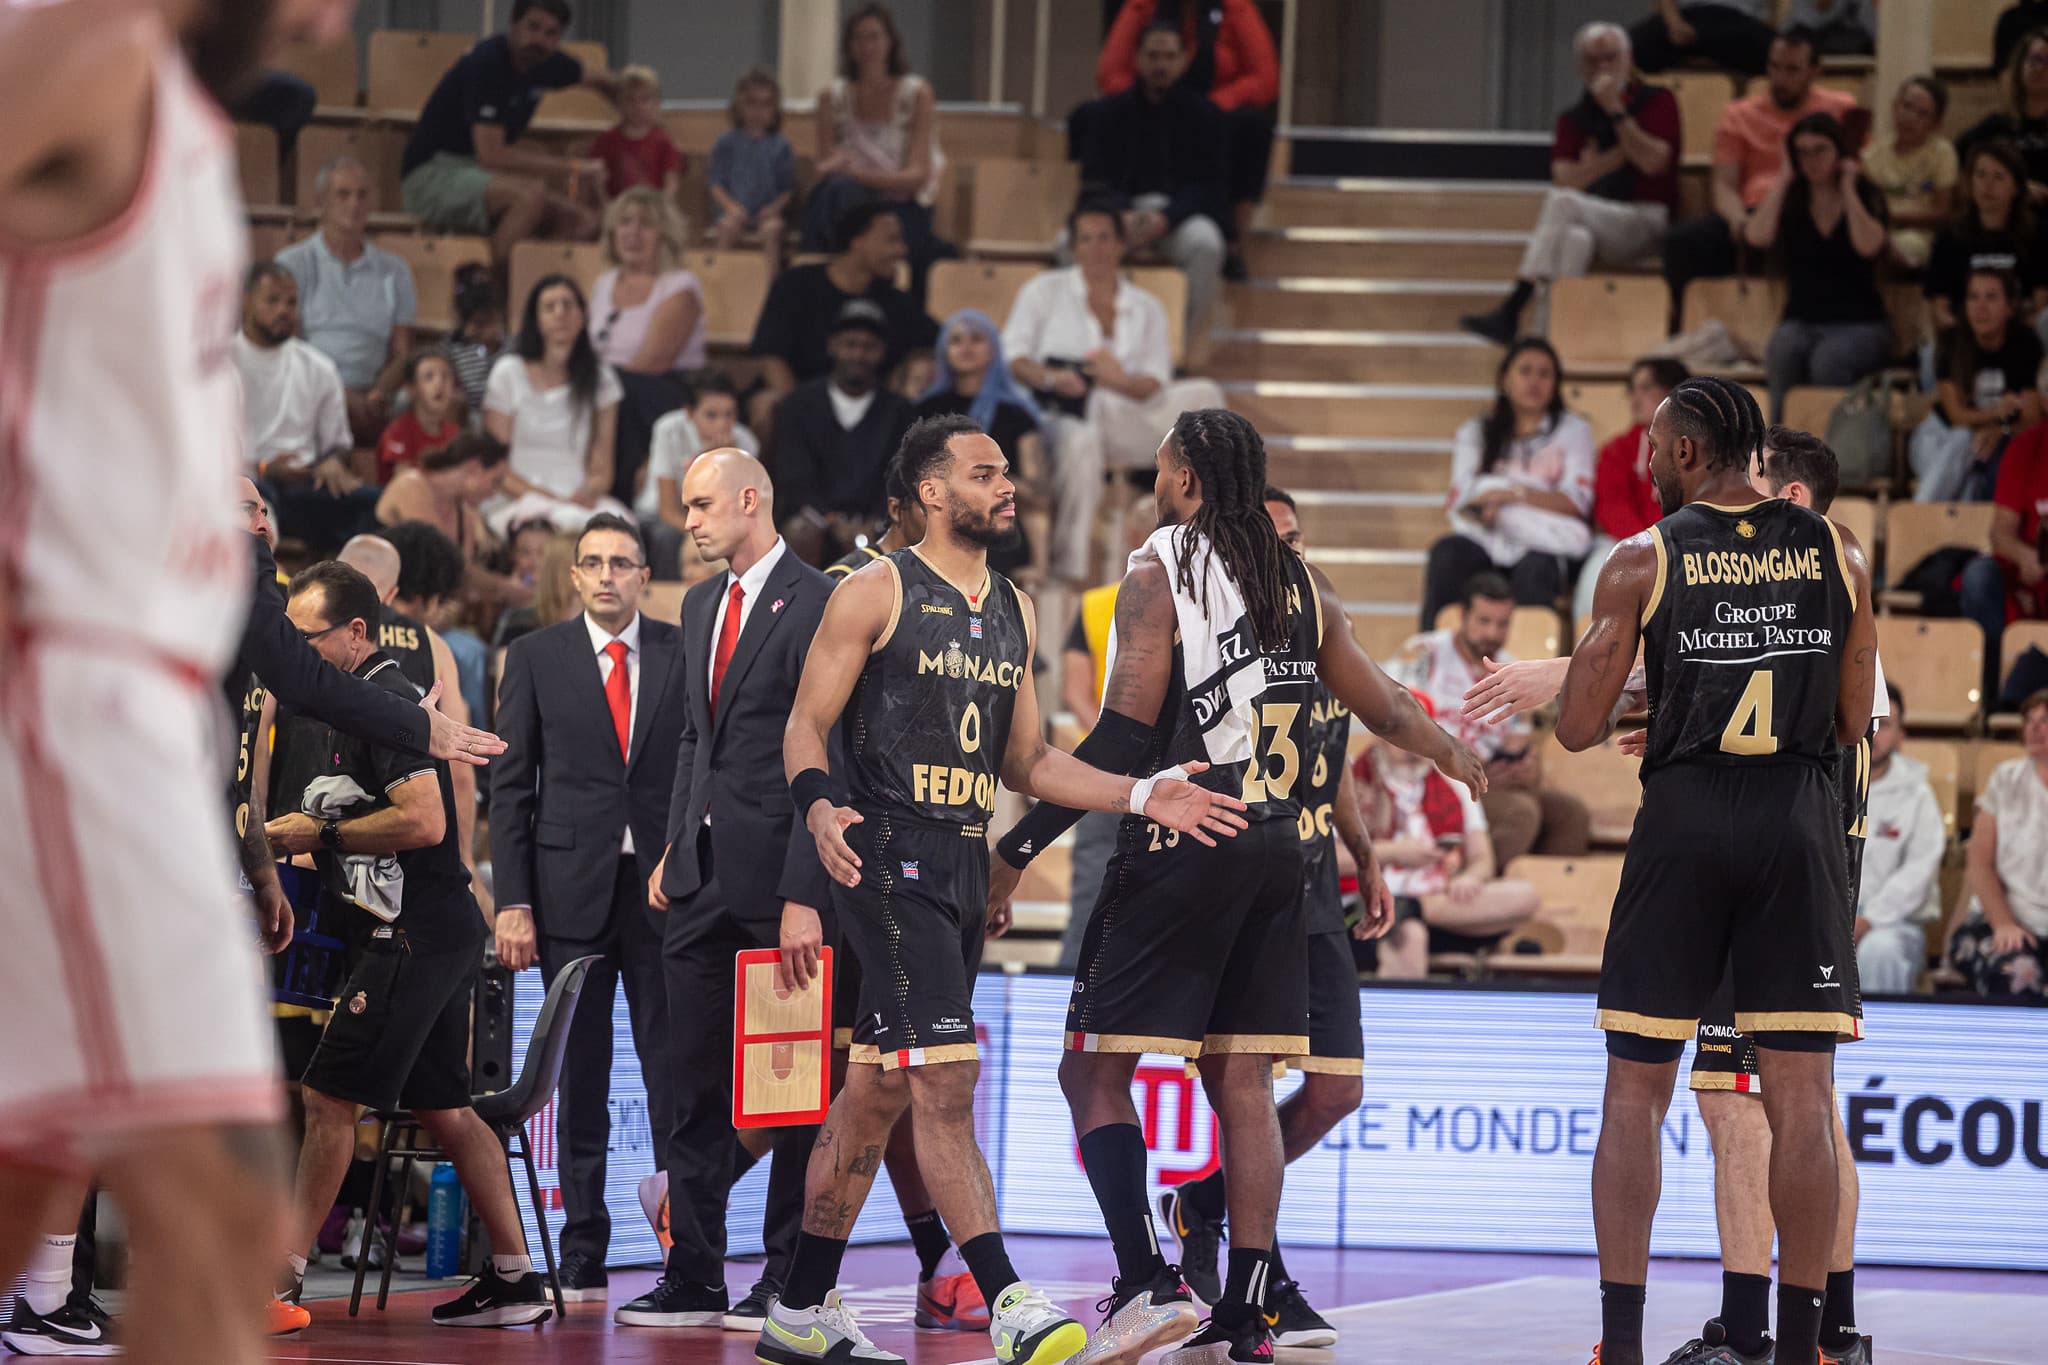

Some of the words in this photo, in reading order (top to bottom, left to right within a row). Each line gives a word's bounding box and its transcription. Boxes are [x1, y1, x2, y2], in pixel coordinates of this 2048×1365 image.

[1683, 548, 1823, 586] BLOSSOMGAME
[920, 603, 953, 616] SPALDING
[1715, 602, 1797, 624] GROUPE
[1678, 628, 1759, 653] MICHEL
[1764, 625, 1832, 646] PASTOR
[959, 701, 981, 753] 0
[1719, 670, 1778, 755] 4
[912, 764, 995, 812] FEDO
[1701, 1042, 1732, 1054] SPALDING
[1408, 1105, 1600, 1154] MONDE
